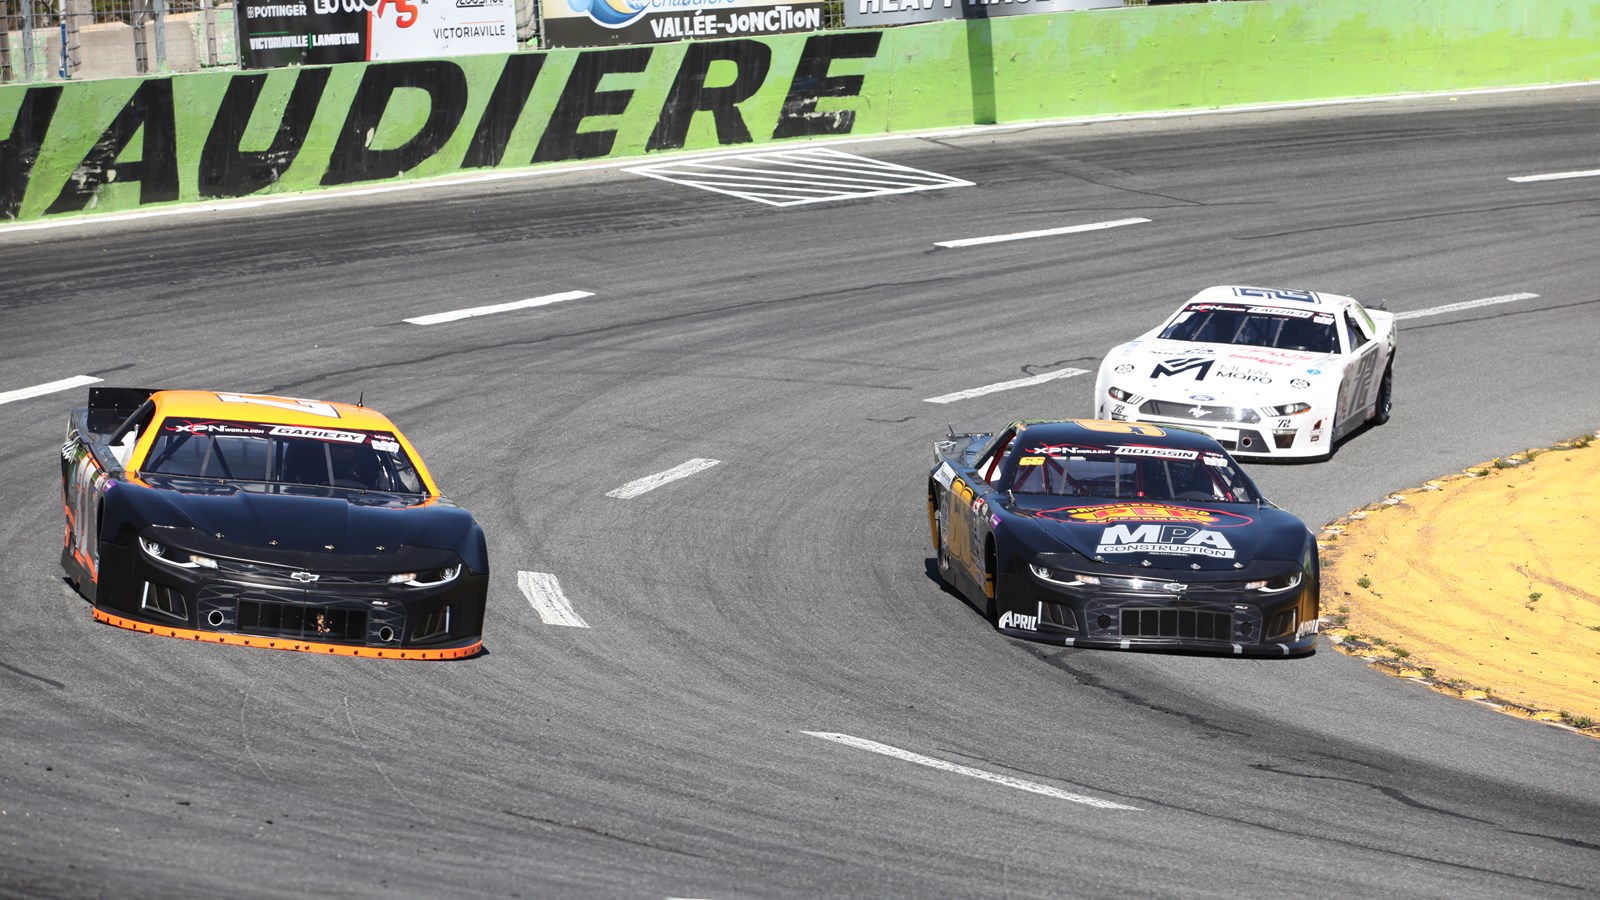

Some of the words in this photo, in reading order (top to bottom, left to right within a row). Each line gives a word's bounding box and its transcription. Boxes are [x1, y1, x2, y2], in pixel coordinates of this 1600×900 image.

[433, 25, 506, 39] VICTORIAVILLE
[249, 35, 309, 50] VICTORIAVILLE
[312, 32, 360, 47] LAMBTON
[1216, 370, 1273, 384] MORO
[175, 424, 225, 433] XPN
[1277, 418, 1292, 428] 72
[277, 426, 360, 441] GARIEPY
[1033, 446, 1077, 454] XPN
[1121, 447, 1194, 458] ROUSSIN
[1100, 524, 1233, 550] MPA
[1103, 543, 1227, 557] CONSTRUCTION
[999, 610, 1038, 631] APRIL
